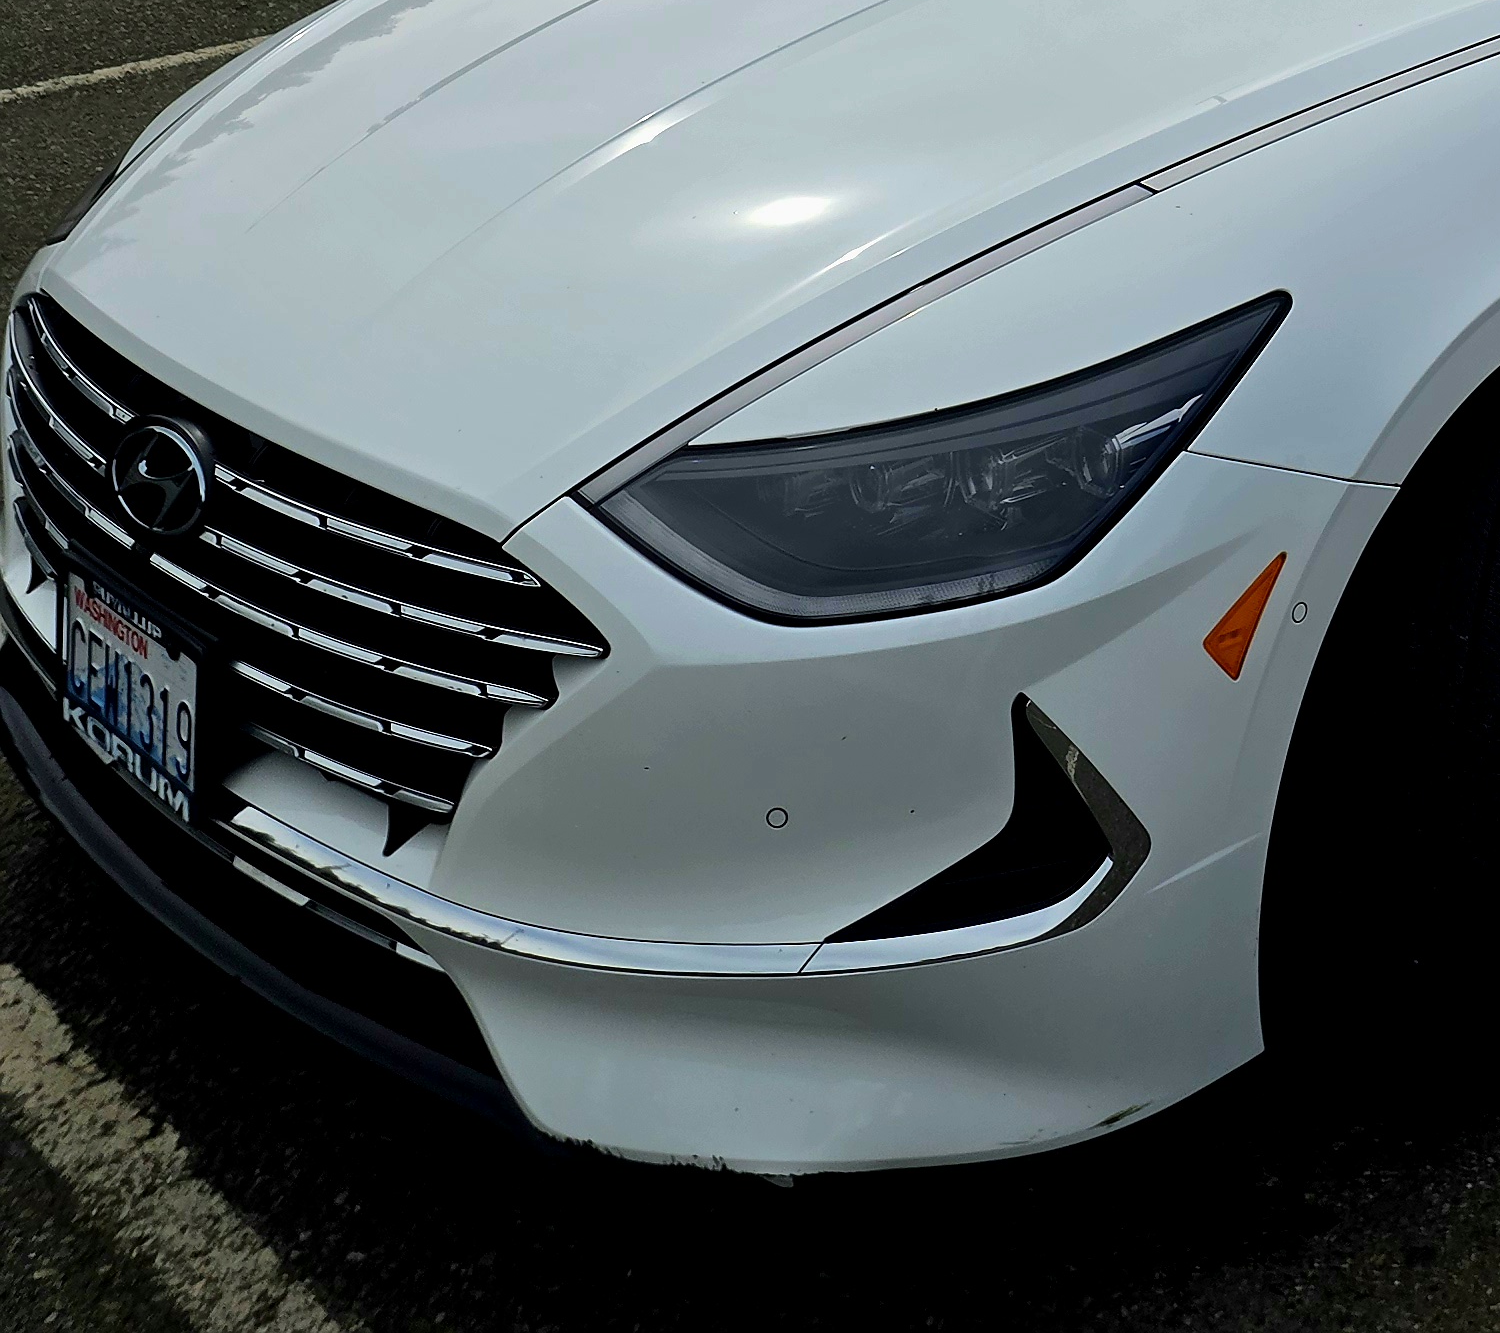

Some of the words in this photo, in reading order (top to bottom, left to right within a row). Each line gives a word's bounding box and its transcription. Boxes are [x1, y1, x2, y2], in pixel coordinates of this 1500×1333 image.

[74, 585, 148, 659] WASHINGTON
[63, 697, 190, 822] KORUM
[71, 618, 191, 782] CEW1319
